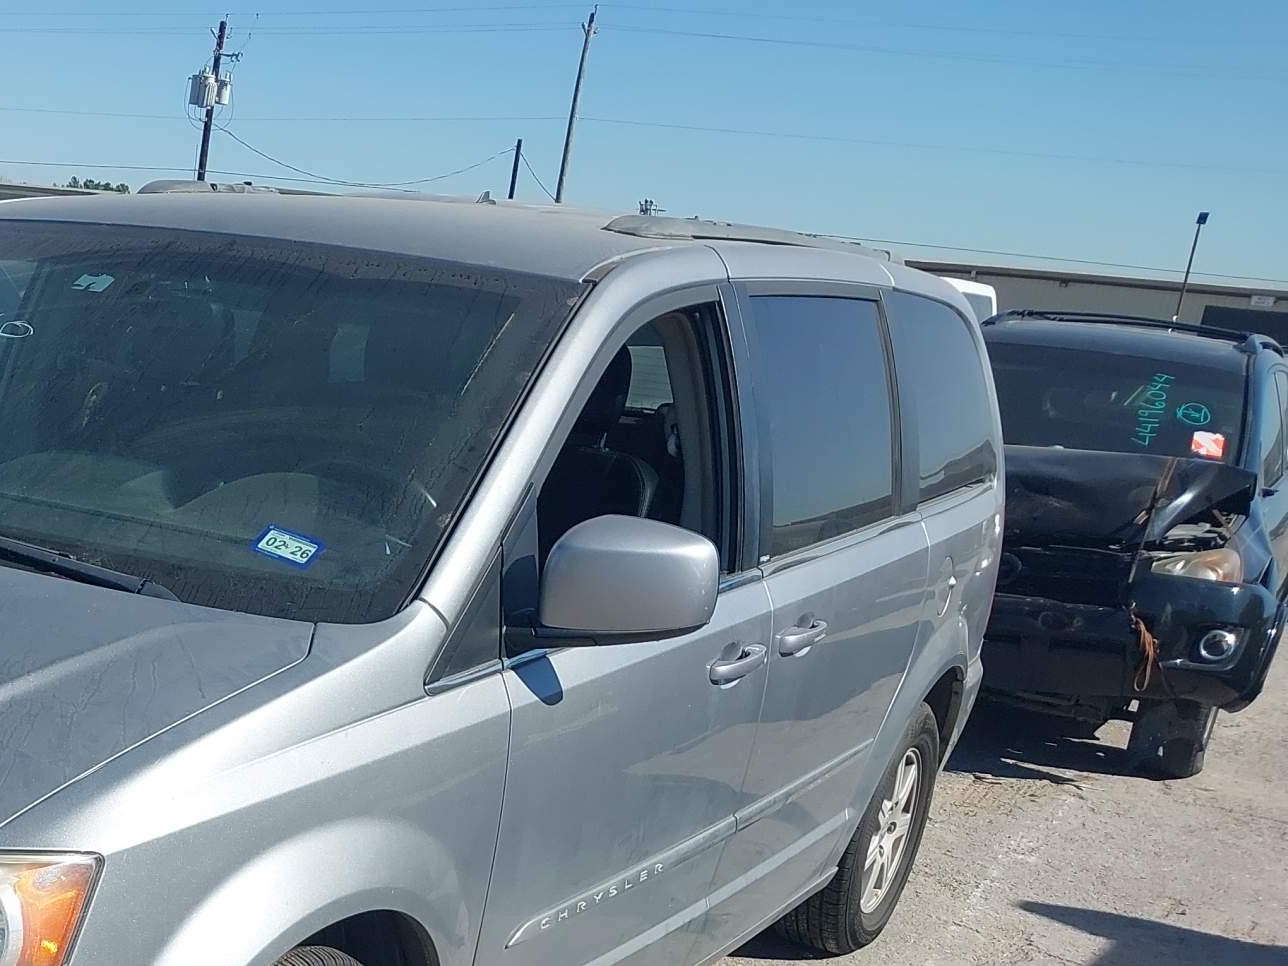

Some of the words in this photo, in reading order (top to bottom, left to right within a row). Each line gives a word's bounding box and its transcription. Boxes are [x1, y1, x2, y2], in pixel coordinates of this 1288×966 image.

[1131, 373, 1175, 447] 44196044
[265, 536, 286, 551] 02
[289, 545, 312, 559] 26
[540, 863, 664, 930] CHRYSLER
